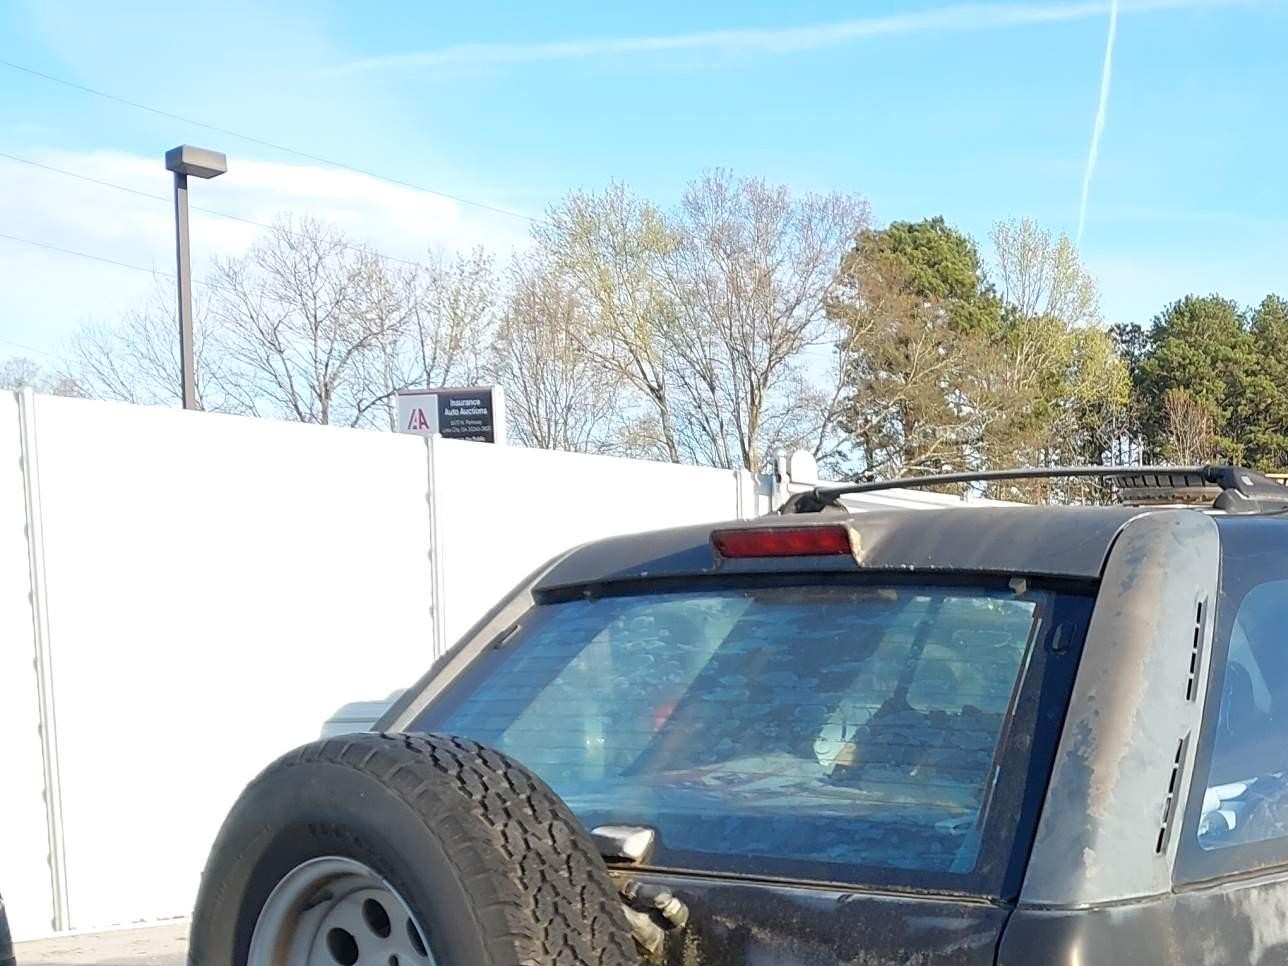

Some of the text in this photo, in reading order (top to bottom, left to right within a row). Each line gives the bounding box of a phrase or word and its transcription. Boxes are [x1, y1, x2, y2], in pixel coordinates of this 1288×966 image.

[449, 399, 481, 407] Insurance
[444, 407, 488, 416] Auto Auctions
